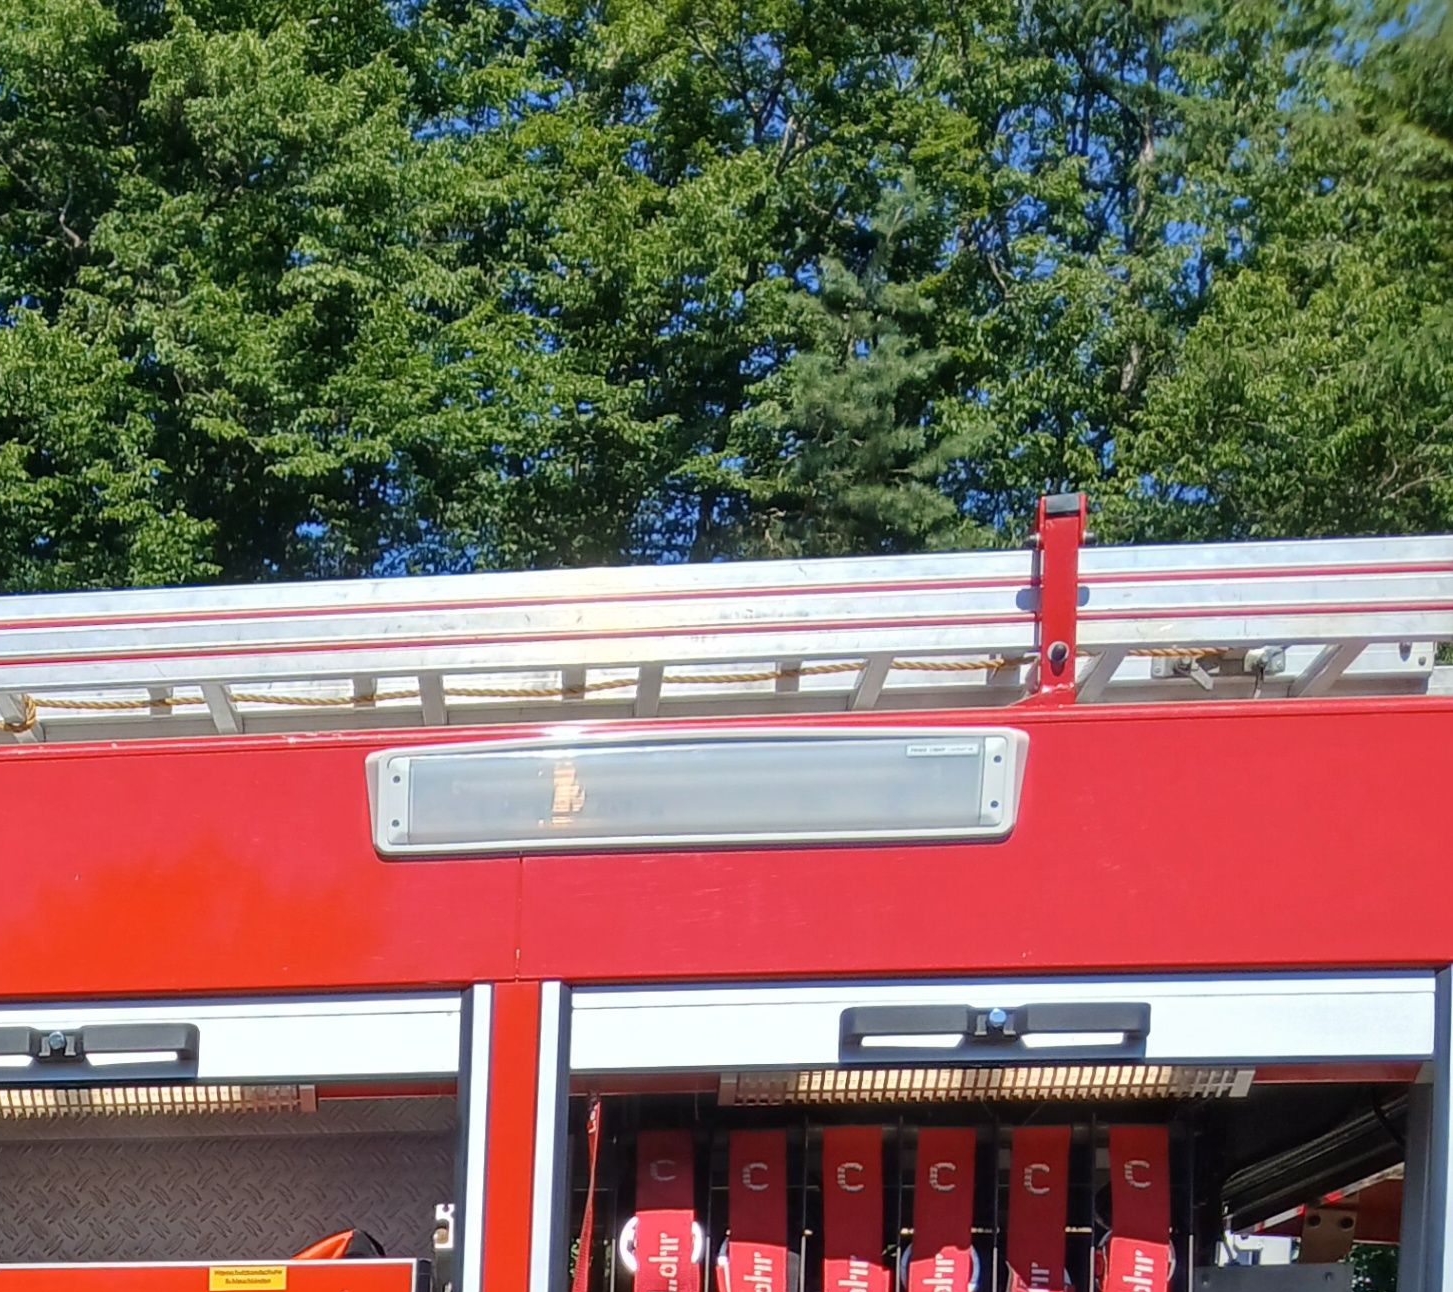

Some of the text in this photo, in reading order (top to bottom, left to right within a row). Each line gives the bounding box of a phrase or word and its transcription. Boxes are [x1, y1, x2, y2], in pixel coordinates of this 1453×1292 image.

[742, 1162, 769, 1190] C
[837, 1162, 864, 1191] C
[929, 1162, 956, 1191] C
[1024, 1163, 1050, 1194] C
[1124, 1159, 1152, 1188] C
